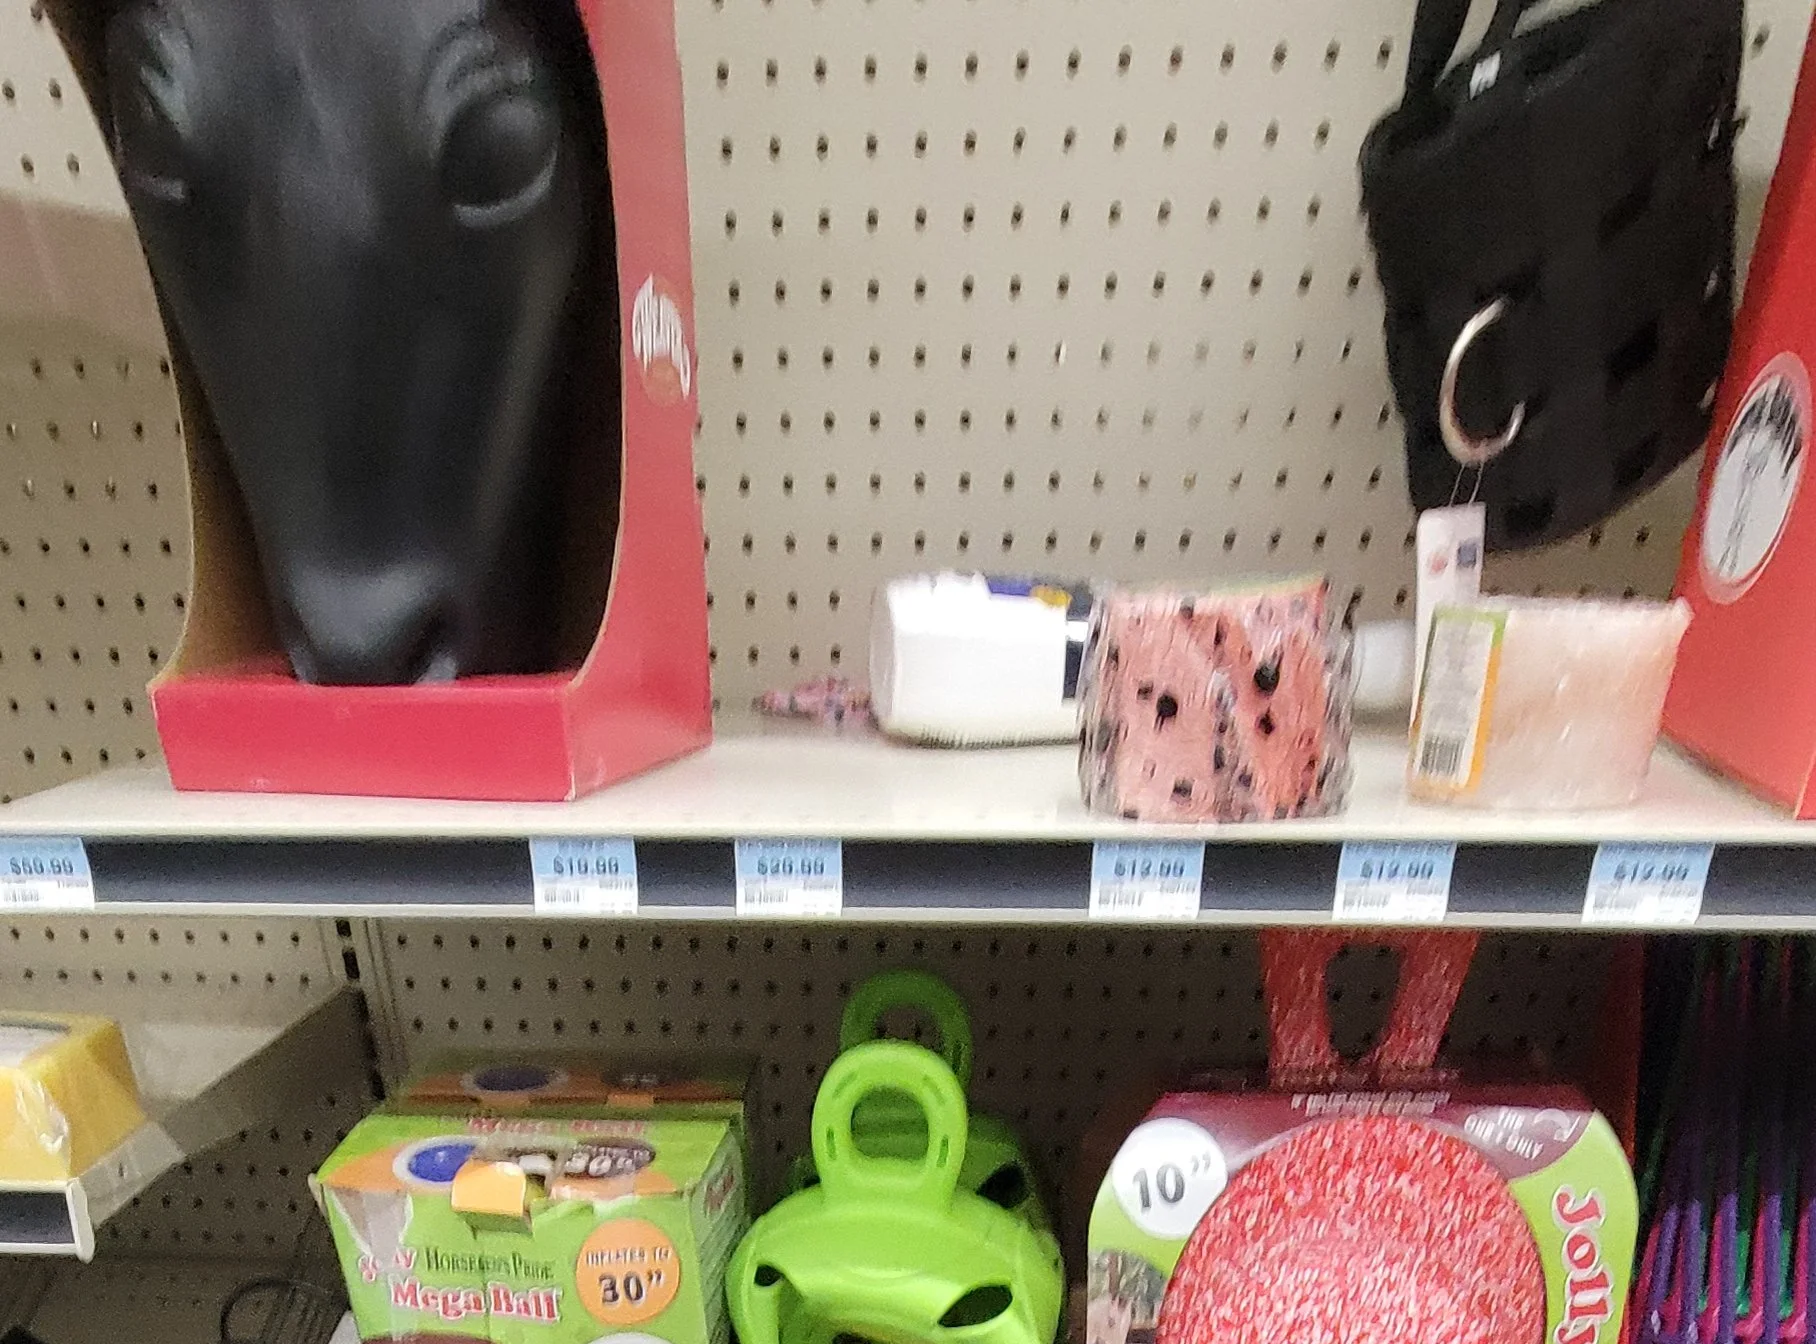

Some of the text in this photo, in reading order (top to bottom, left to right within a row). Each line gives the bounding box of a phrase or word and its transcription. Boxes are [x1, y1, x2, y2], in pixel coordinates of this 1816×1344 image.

[1131, 1152, 1213, 1213] 10"
[389, 1276, 563, 1323] Mega Ball
